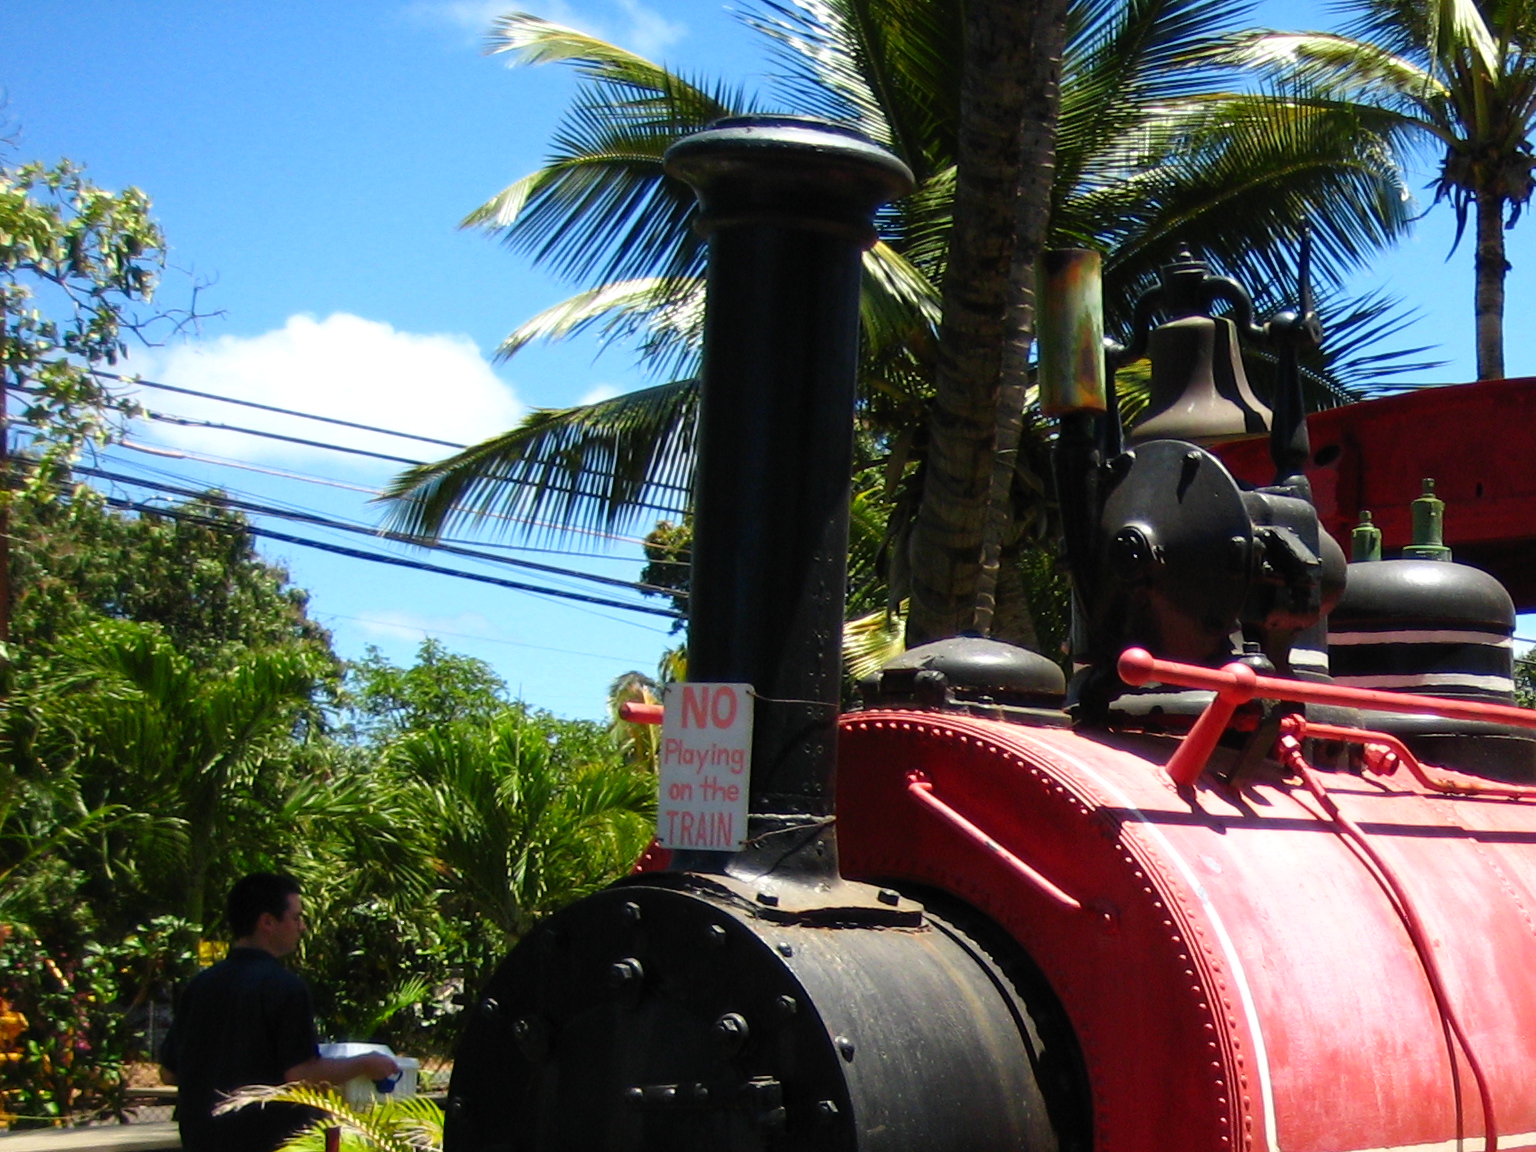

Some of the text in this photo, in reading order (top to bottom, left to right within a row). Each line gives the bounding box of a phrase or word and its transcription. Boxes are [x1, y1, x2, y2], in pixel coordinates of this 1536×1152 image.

[681, 686, 738, 729] NO
[664, 738, 745, 775] Playing
[668, 776, 740, 802] on the
[666, 811, 733, 847] TRAIN
